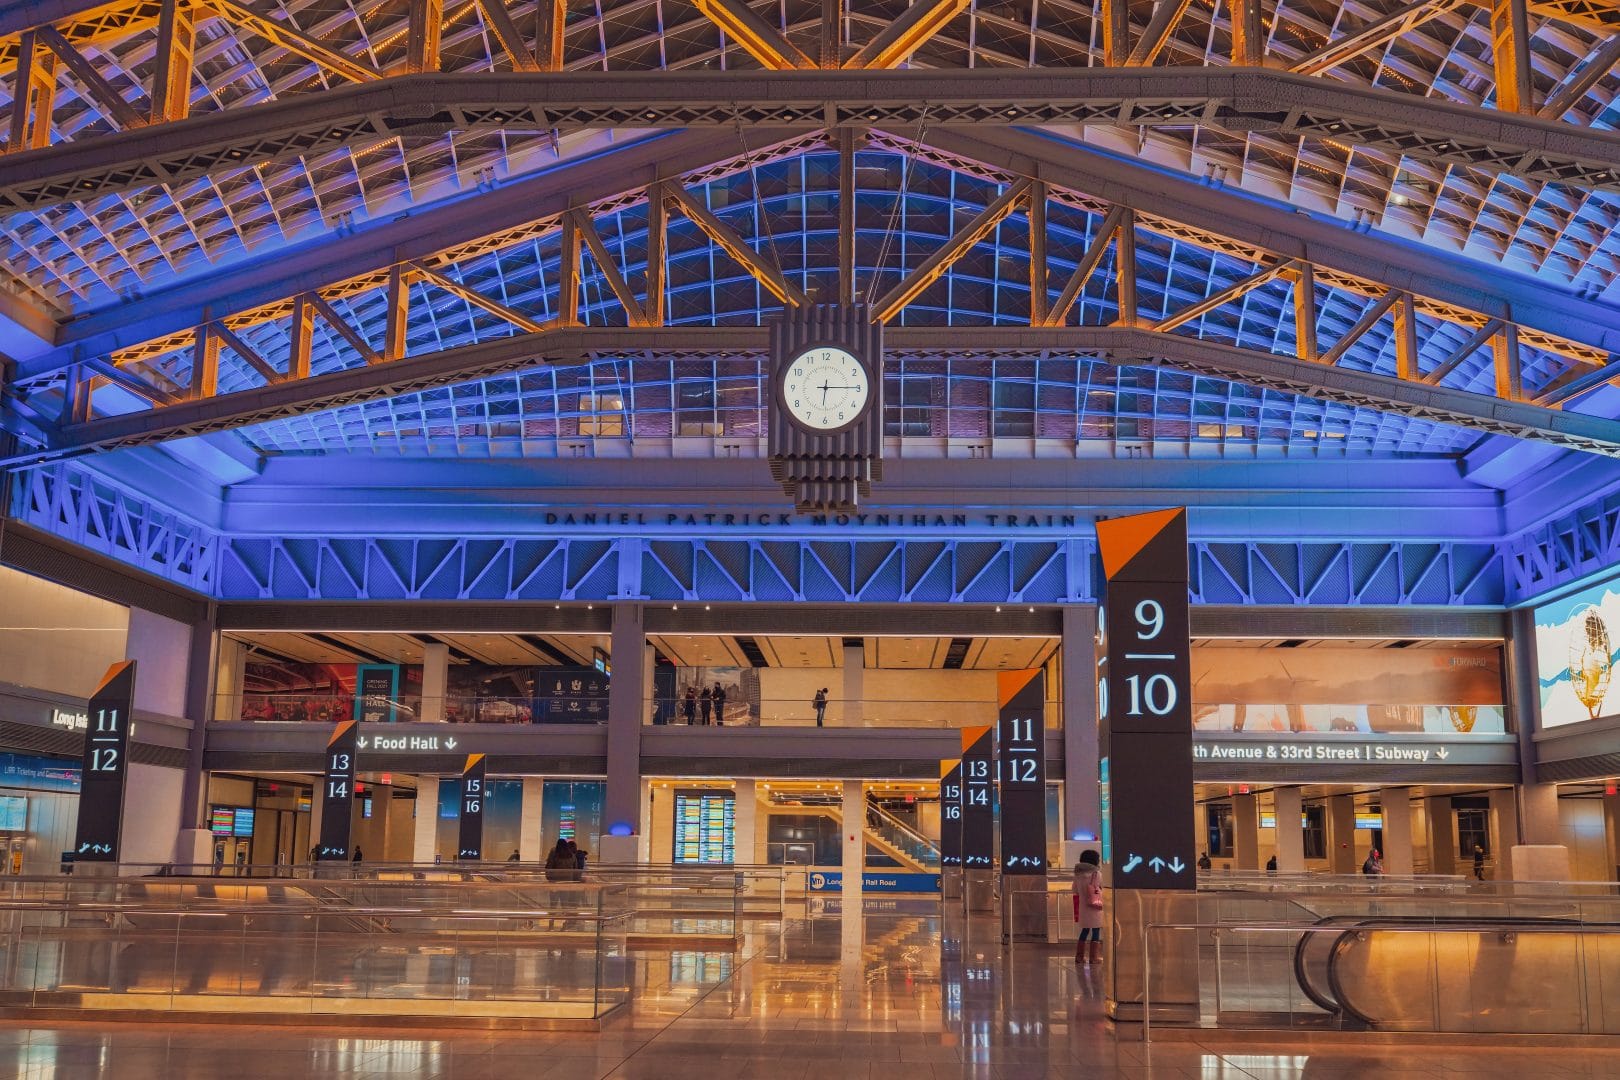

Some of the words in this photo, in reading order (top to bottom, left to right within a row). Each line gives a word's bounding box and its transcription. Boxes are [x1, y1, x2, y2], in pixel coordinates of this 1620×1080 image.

[806, 356, 814, 365] 11
[822, 352, 831, 361] 12
[841, 356, 845, 365] 1
[793, 368, 803, 376] 10
[851, 368, 857, 377] 2
[790, 384, 796, 393] 9
[855, 384, 861, 393] 3
[794, 400, 800, 408] 8
[851, 400, 856, 408] 4
[806, 411, 812, 420] 7
[822, 416, 828, 425] 6
[838, 411, 844, 420] 5
[545, 512, 647, 526] DANIEL
[667, 512, 792, 527] PATRICK
[811, 513, 966, 528] MOYNIHAN
[986, 514, 1075, 528] TRAIN
[1134, 599, 1164, 640] 9
[1125, 674, 1177, 715] 10
[53, 709, 76, 730] Long
[95, 709, 118, 732] 11
[1010, 718, 1034, 741] 11
[373, 736, 407, 750] Food
[410, 736, 439, 750] Hall
[90, 748, 118, 771] 12
[1211, 744, 1263, 759] Avenue
[1266, 746, 1278, 759] &
[1280, 745, 1313, 759] 33rd
[1315, 745, 1360, 760] Street
[1375, 745, 1430, 762] Subway
[331, 754, 350, 770] 13
[968, 760, 988, 777] 13
[1009, 759, 1037, 782] 12
[327, 781, 348, 798] 14
[465, 779, 480, 792] 15
[945, 785, 960, 798] 15
[968, 788, 988, 805] 14
[465, 800, 480, 813] 16
[945, 806, 960, 819] 16
